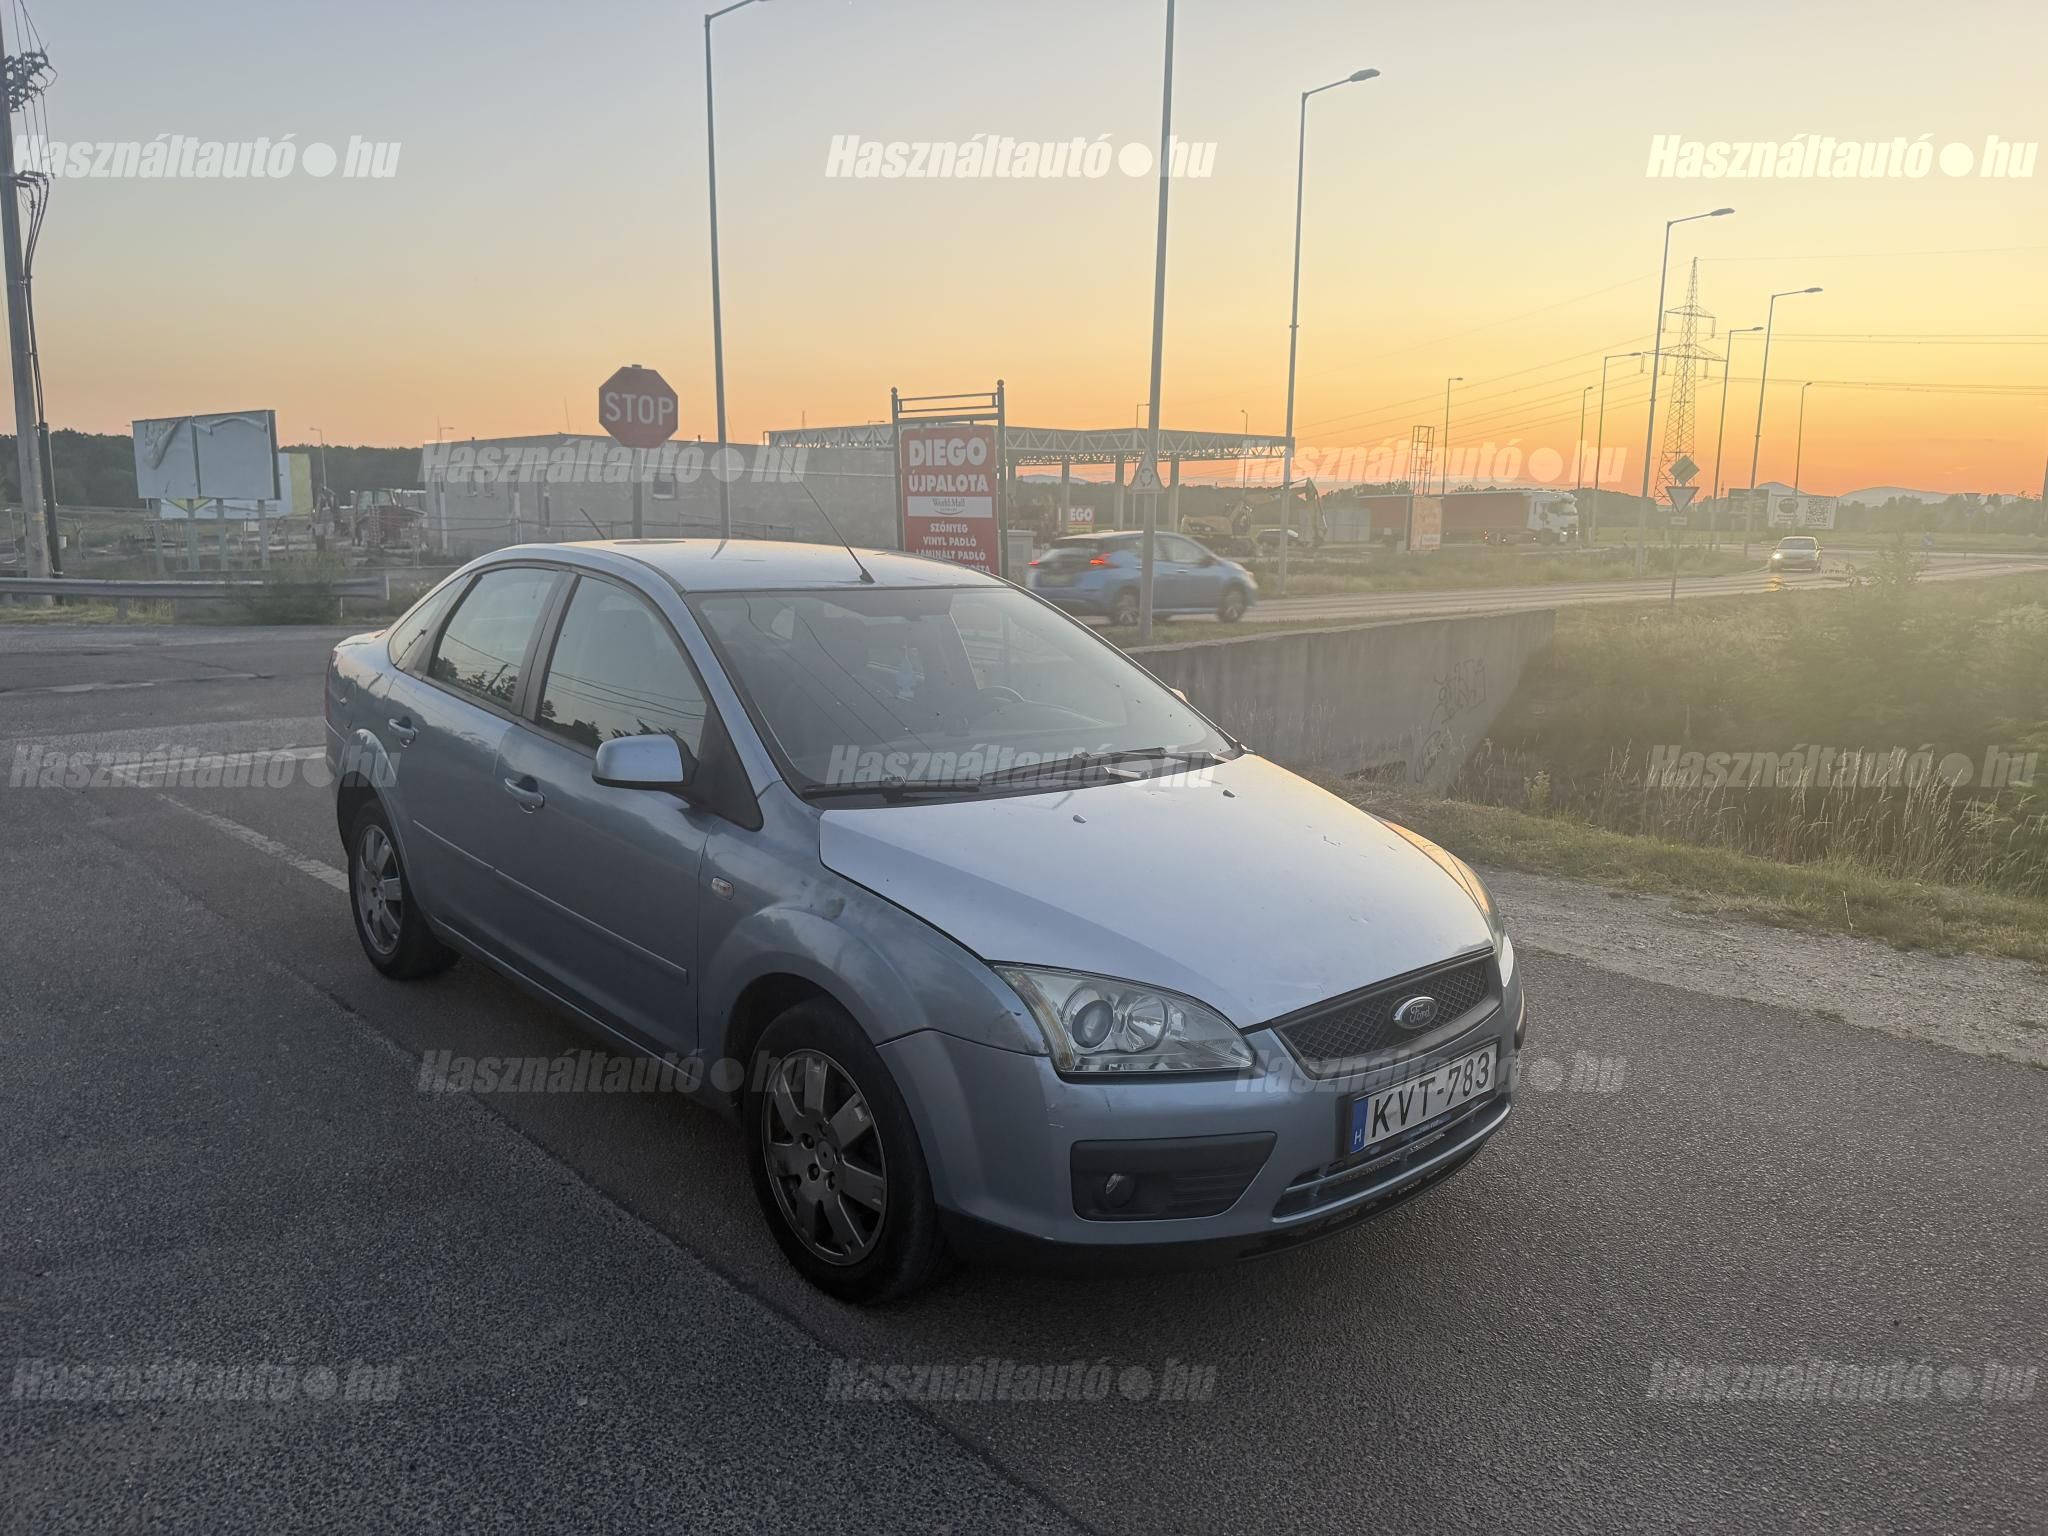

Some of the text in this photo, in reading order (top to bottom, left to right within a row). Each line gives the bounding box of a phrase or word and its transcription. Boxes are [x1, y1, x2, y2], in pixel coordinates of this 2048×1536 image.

[605, 392, 674, 425] STOP
[909, 437, 987, 466] DIEGO
[908, 470, 989, 492] ÚJPALOTA
[923, 535, 947, 546] VINYL
[1410, 1003, 1430, 1023] Ford
[1371, 1051, 1490, 1138] KVT-783
[1354, 1128, 1362, 1145] H
